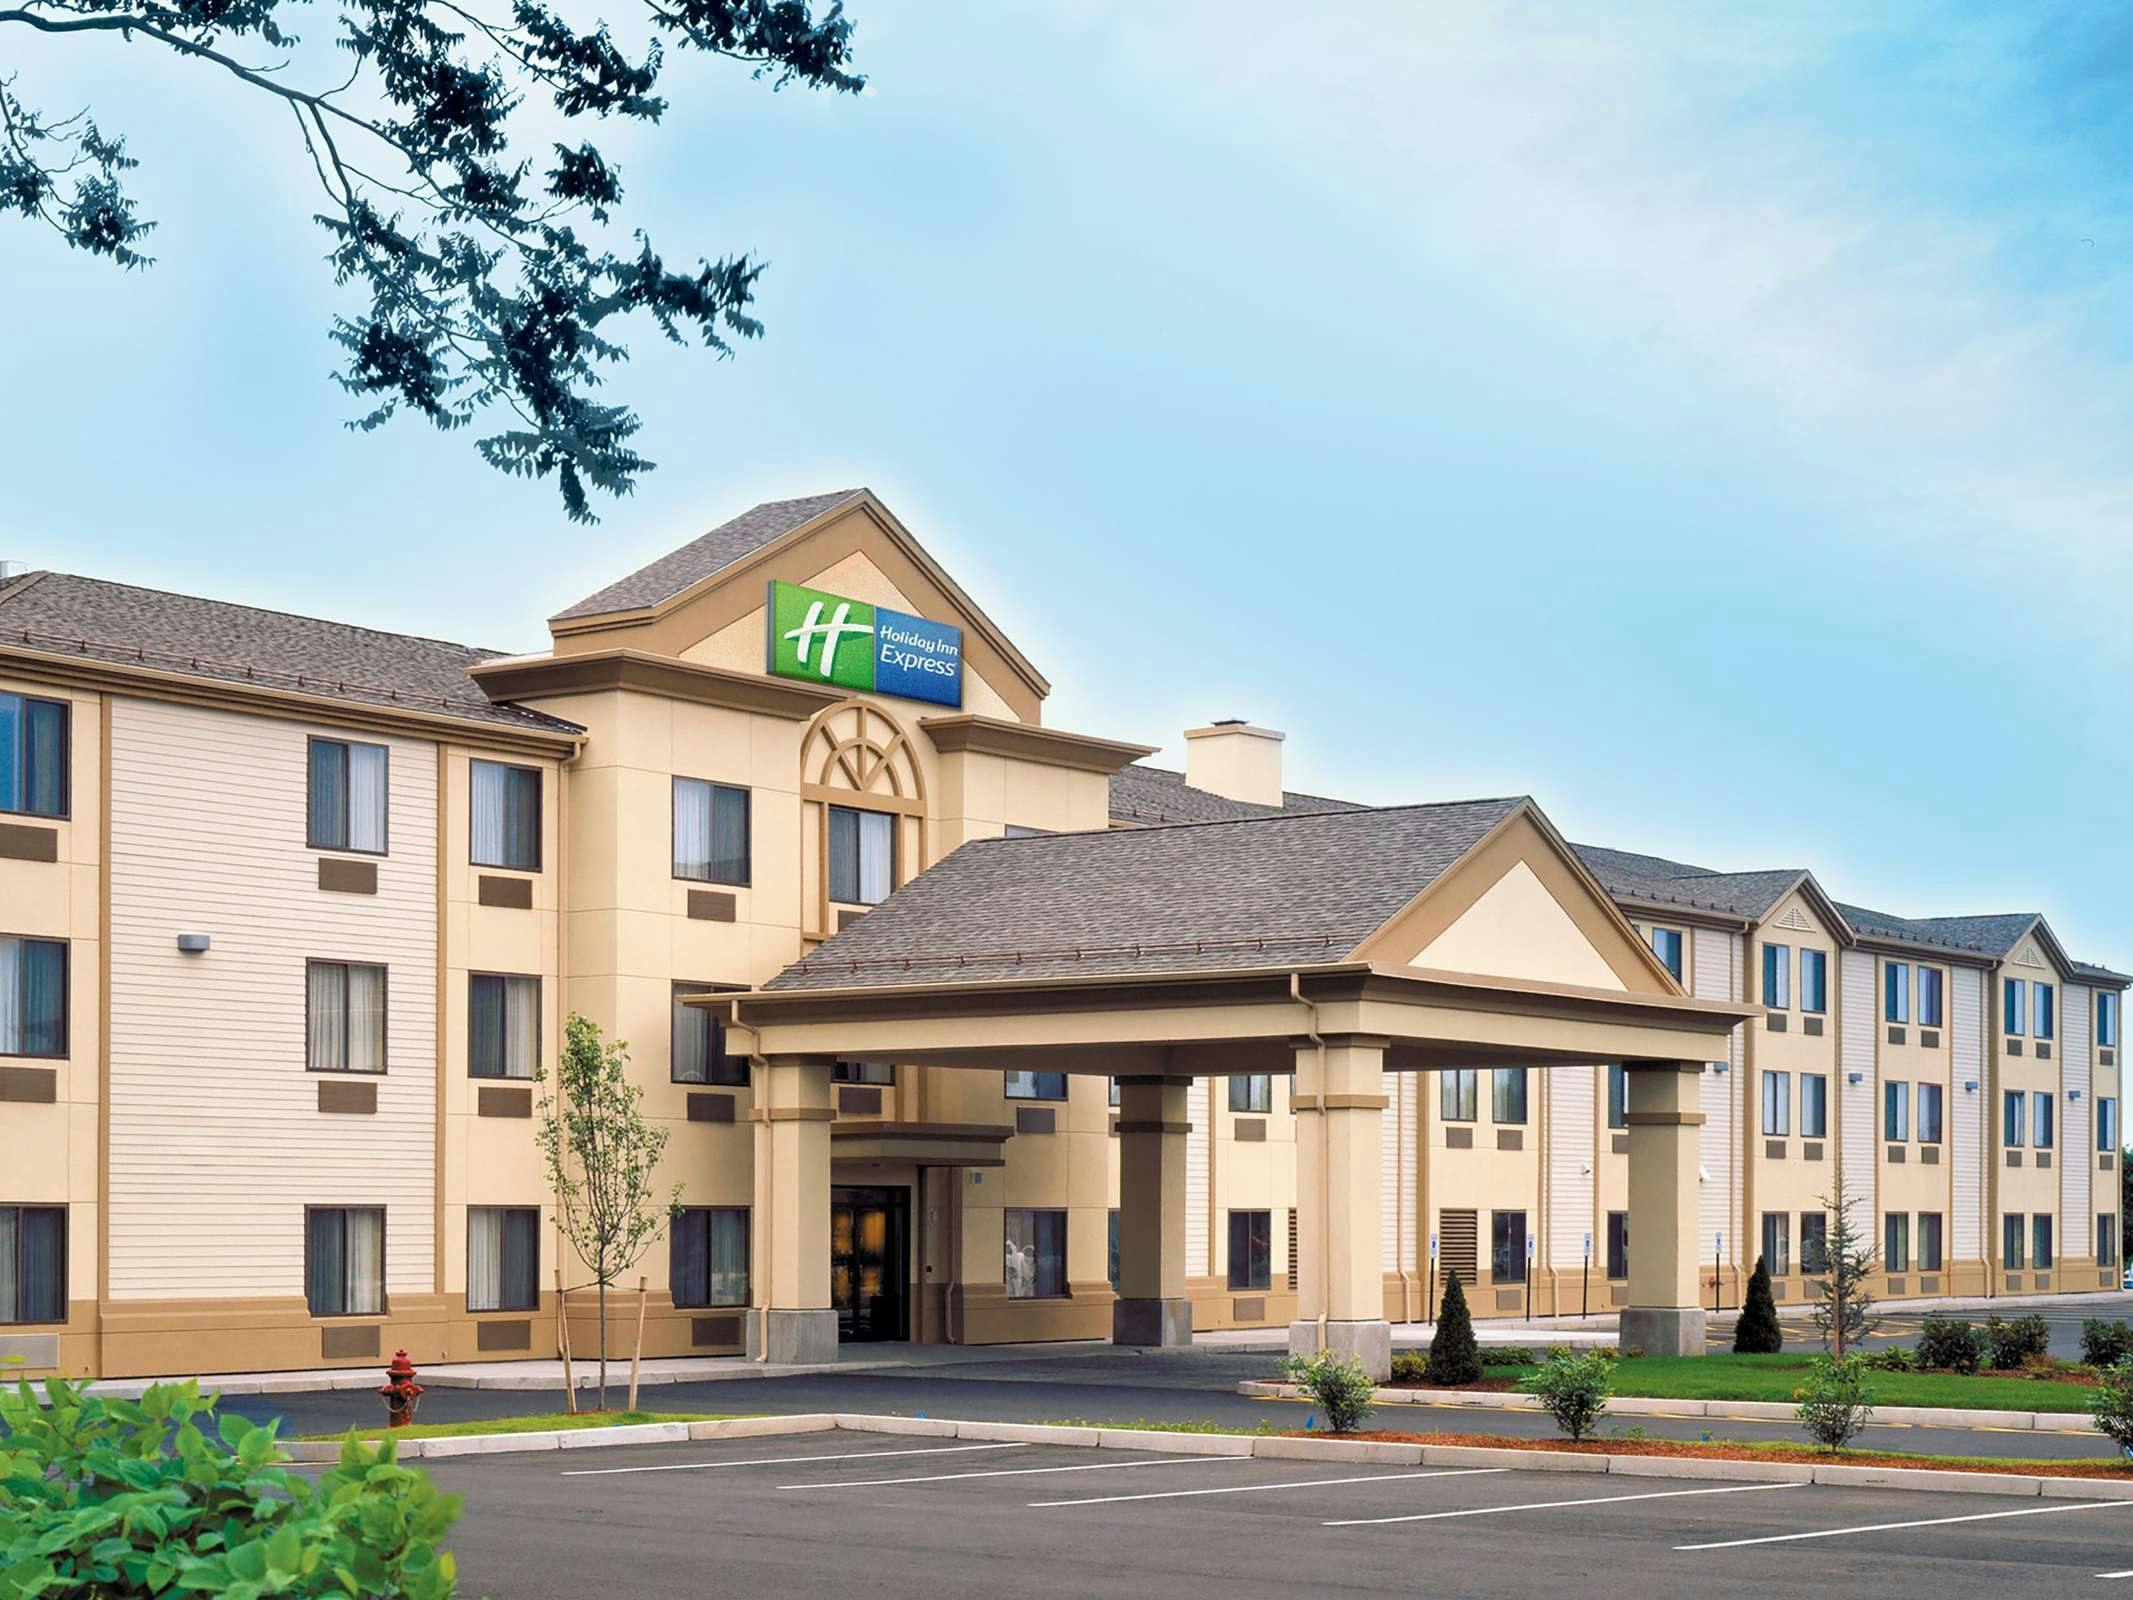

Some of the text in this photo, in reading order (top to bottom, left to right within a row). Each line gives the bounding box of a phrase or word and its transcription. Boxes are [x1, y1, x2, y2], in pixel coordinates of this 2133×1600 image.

[880, 625, 959, 656] Holiday Inn
[880, 643, 956, 677] Express
